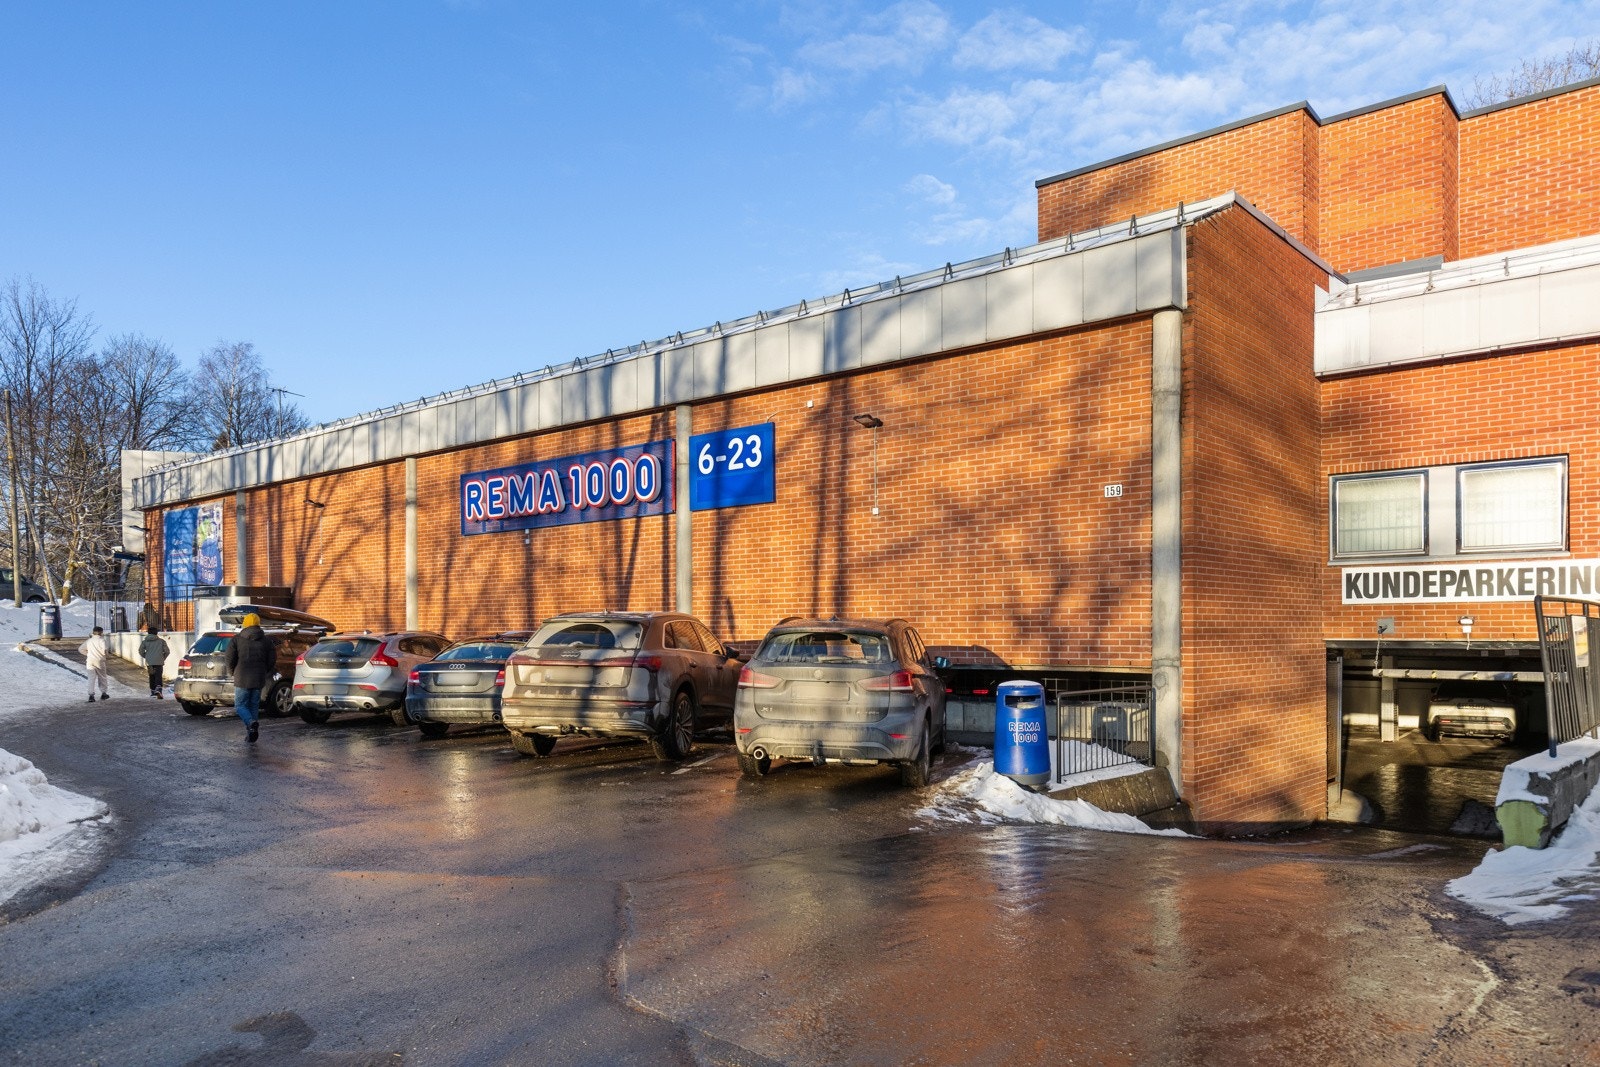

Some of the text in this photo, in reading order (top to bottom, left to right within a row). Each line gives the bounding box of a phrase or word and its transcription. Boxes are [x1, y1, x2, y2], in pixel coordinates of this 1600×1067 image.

[698, 434, 762, 475] 6-23
[465, 453, 660, 522] REMA 1000
[1106, 486, 1121, 496] 159
[1008, 721, 1041, 732] REMA
[1012, 732, 1039, 743] 1000
